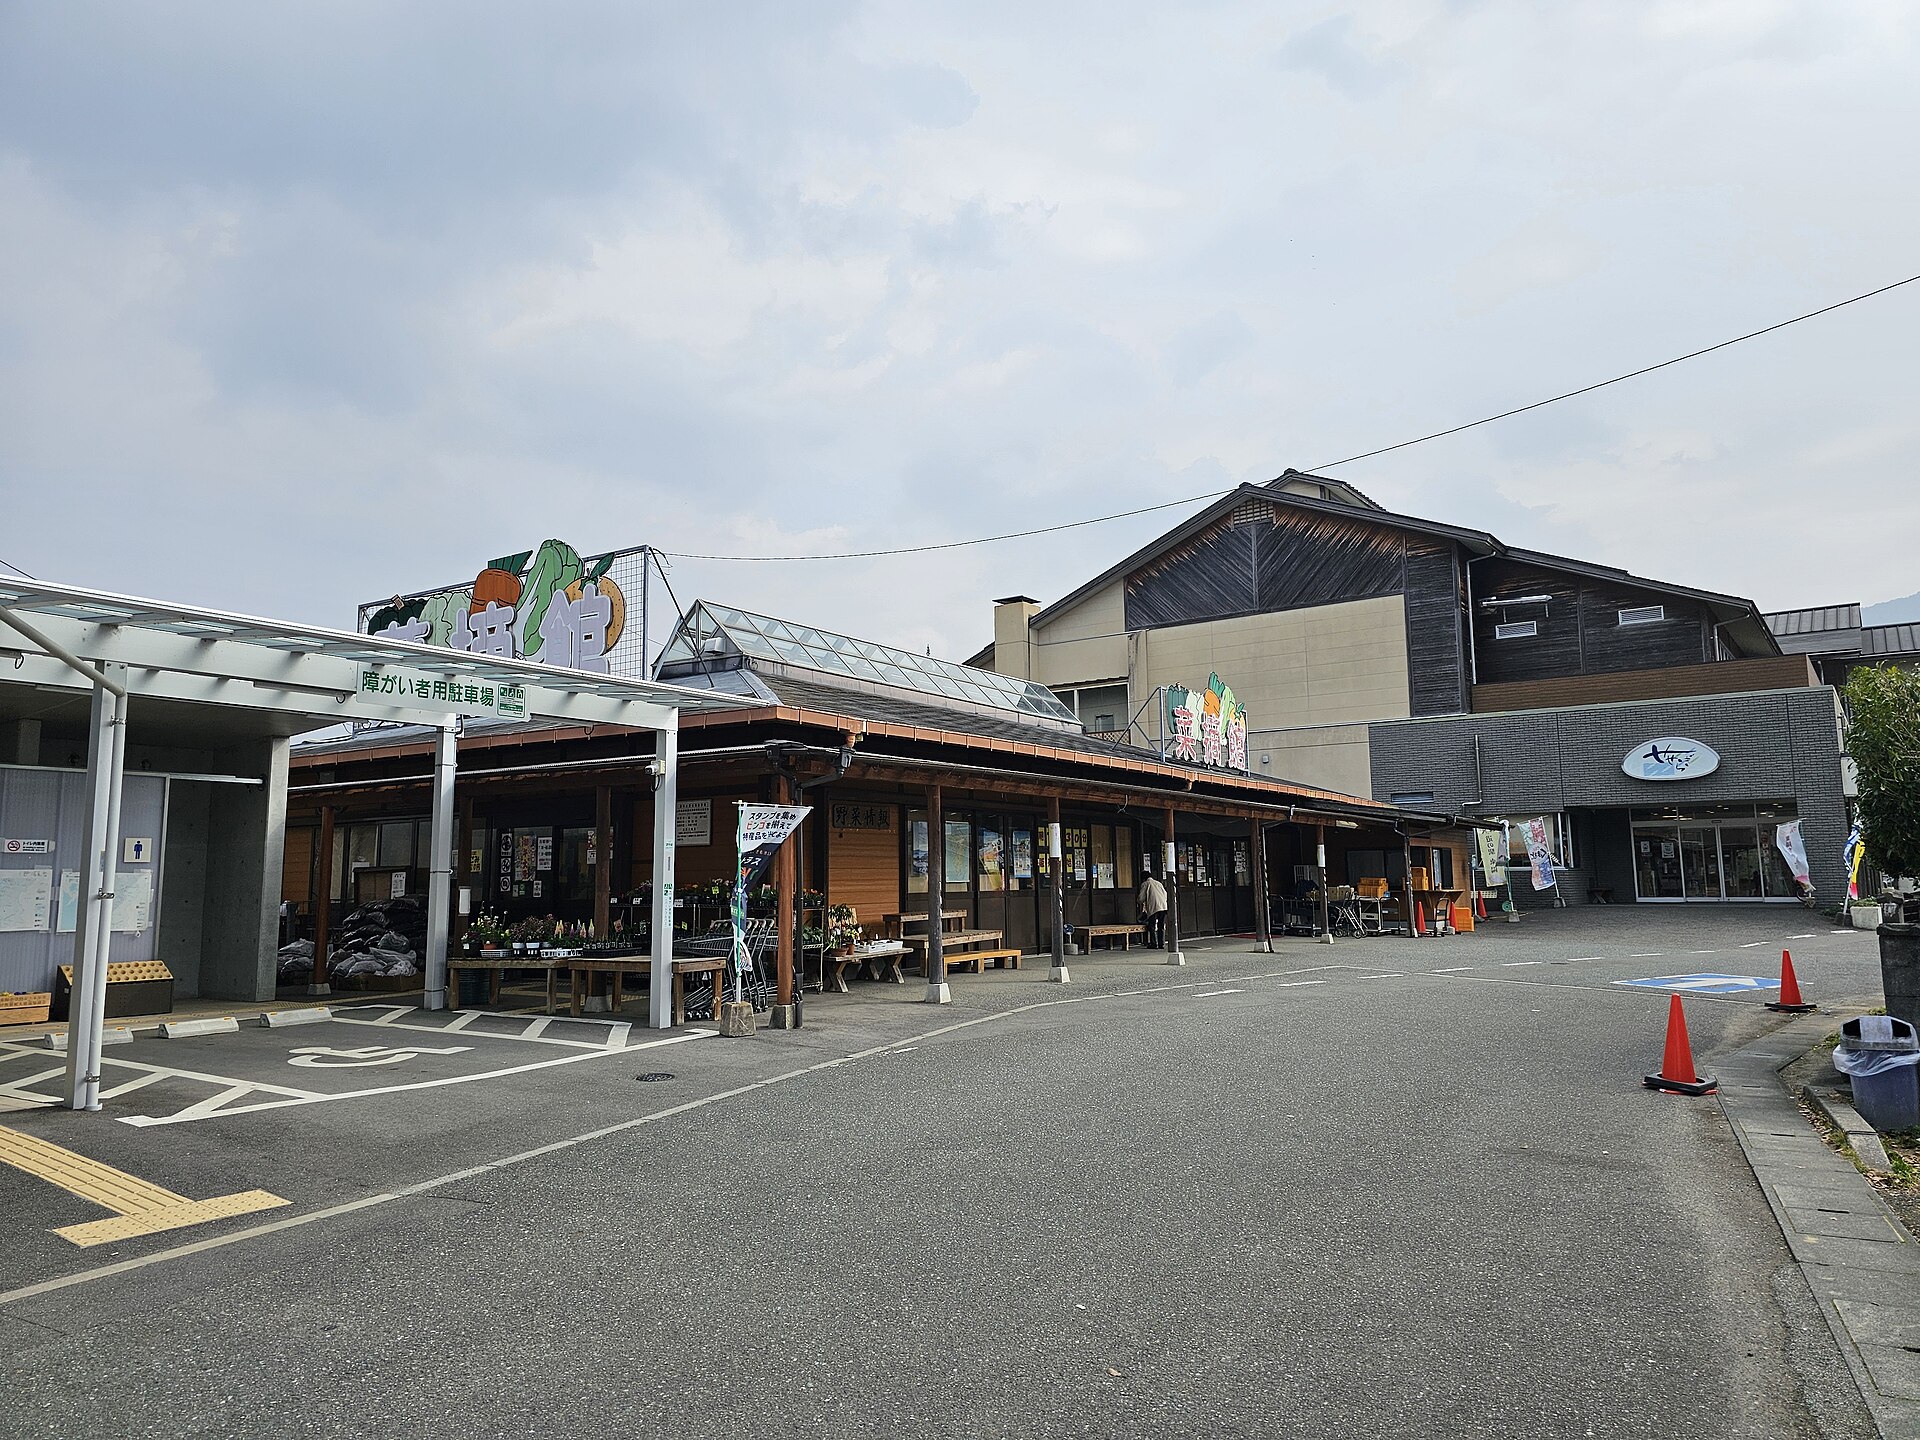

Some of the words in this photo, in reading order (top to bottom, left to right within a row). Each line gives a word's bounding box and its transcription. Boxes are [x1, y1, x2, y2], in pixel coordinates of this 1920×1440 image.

[361, 670, 495, 708] 障がい者用駐車場
[1174, 705, 1246, 770] 菜摘館
[749, 810, 797, 821] スタンプを集め
[833, 806, 891, 827] 野菜情報
